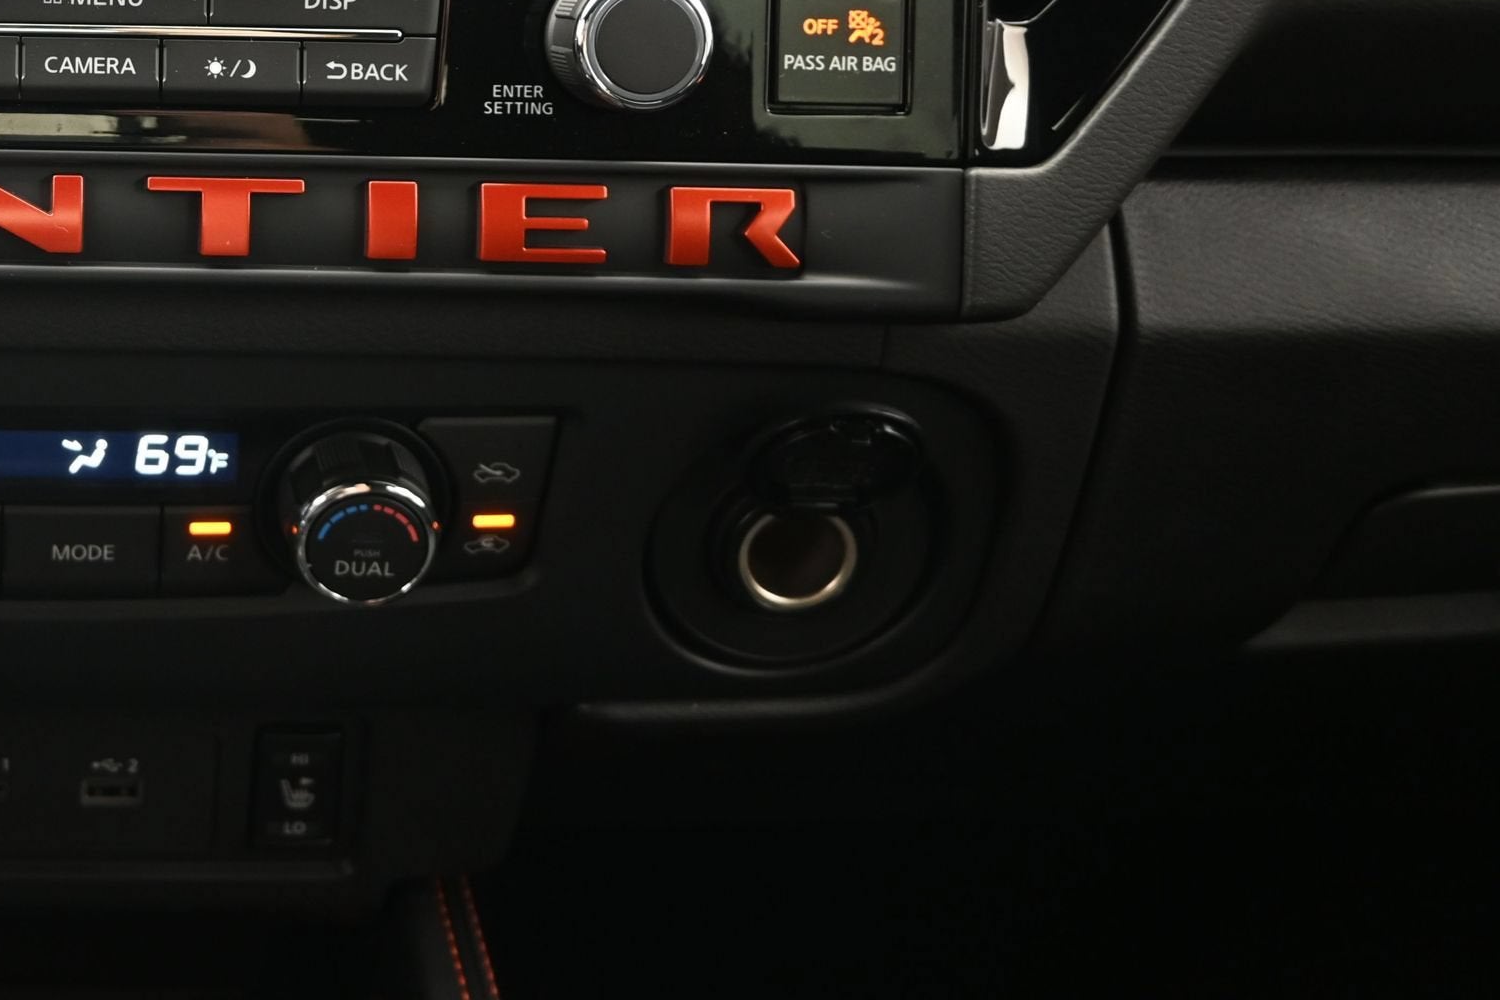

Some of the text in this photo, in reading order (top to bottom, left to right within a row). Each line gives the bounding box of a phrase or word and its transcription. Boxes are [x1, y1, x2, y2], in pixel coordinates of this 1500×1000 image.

[802, 18, 839, 36] OFF
[43, 55, 137, 76] CAMERA
[350, 62, 409, 82] BACK
[783, 54, 897, 72] PASS AIR BAG
[492, 84, 544, 99] ENTER
[483, 101, 554, 116] SETTING
[52, 544, 115, 562] MODE
[187, 544, 230, 562] A/C
[353, 549, 381, 559] PUSH
[334, 560, 396, 578] DUAL
[127, 757, 139, 773] 2
[282, 820, 308, 835] LO
